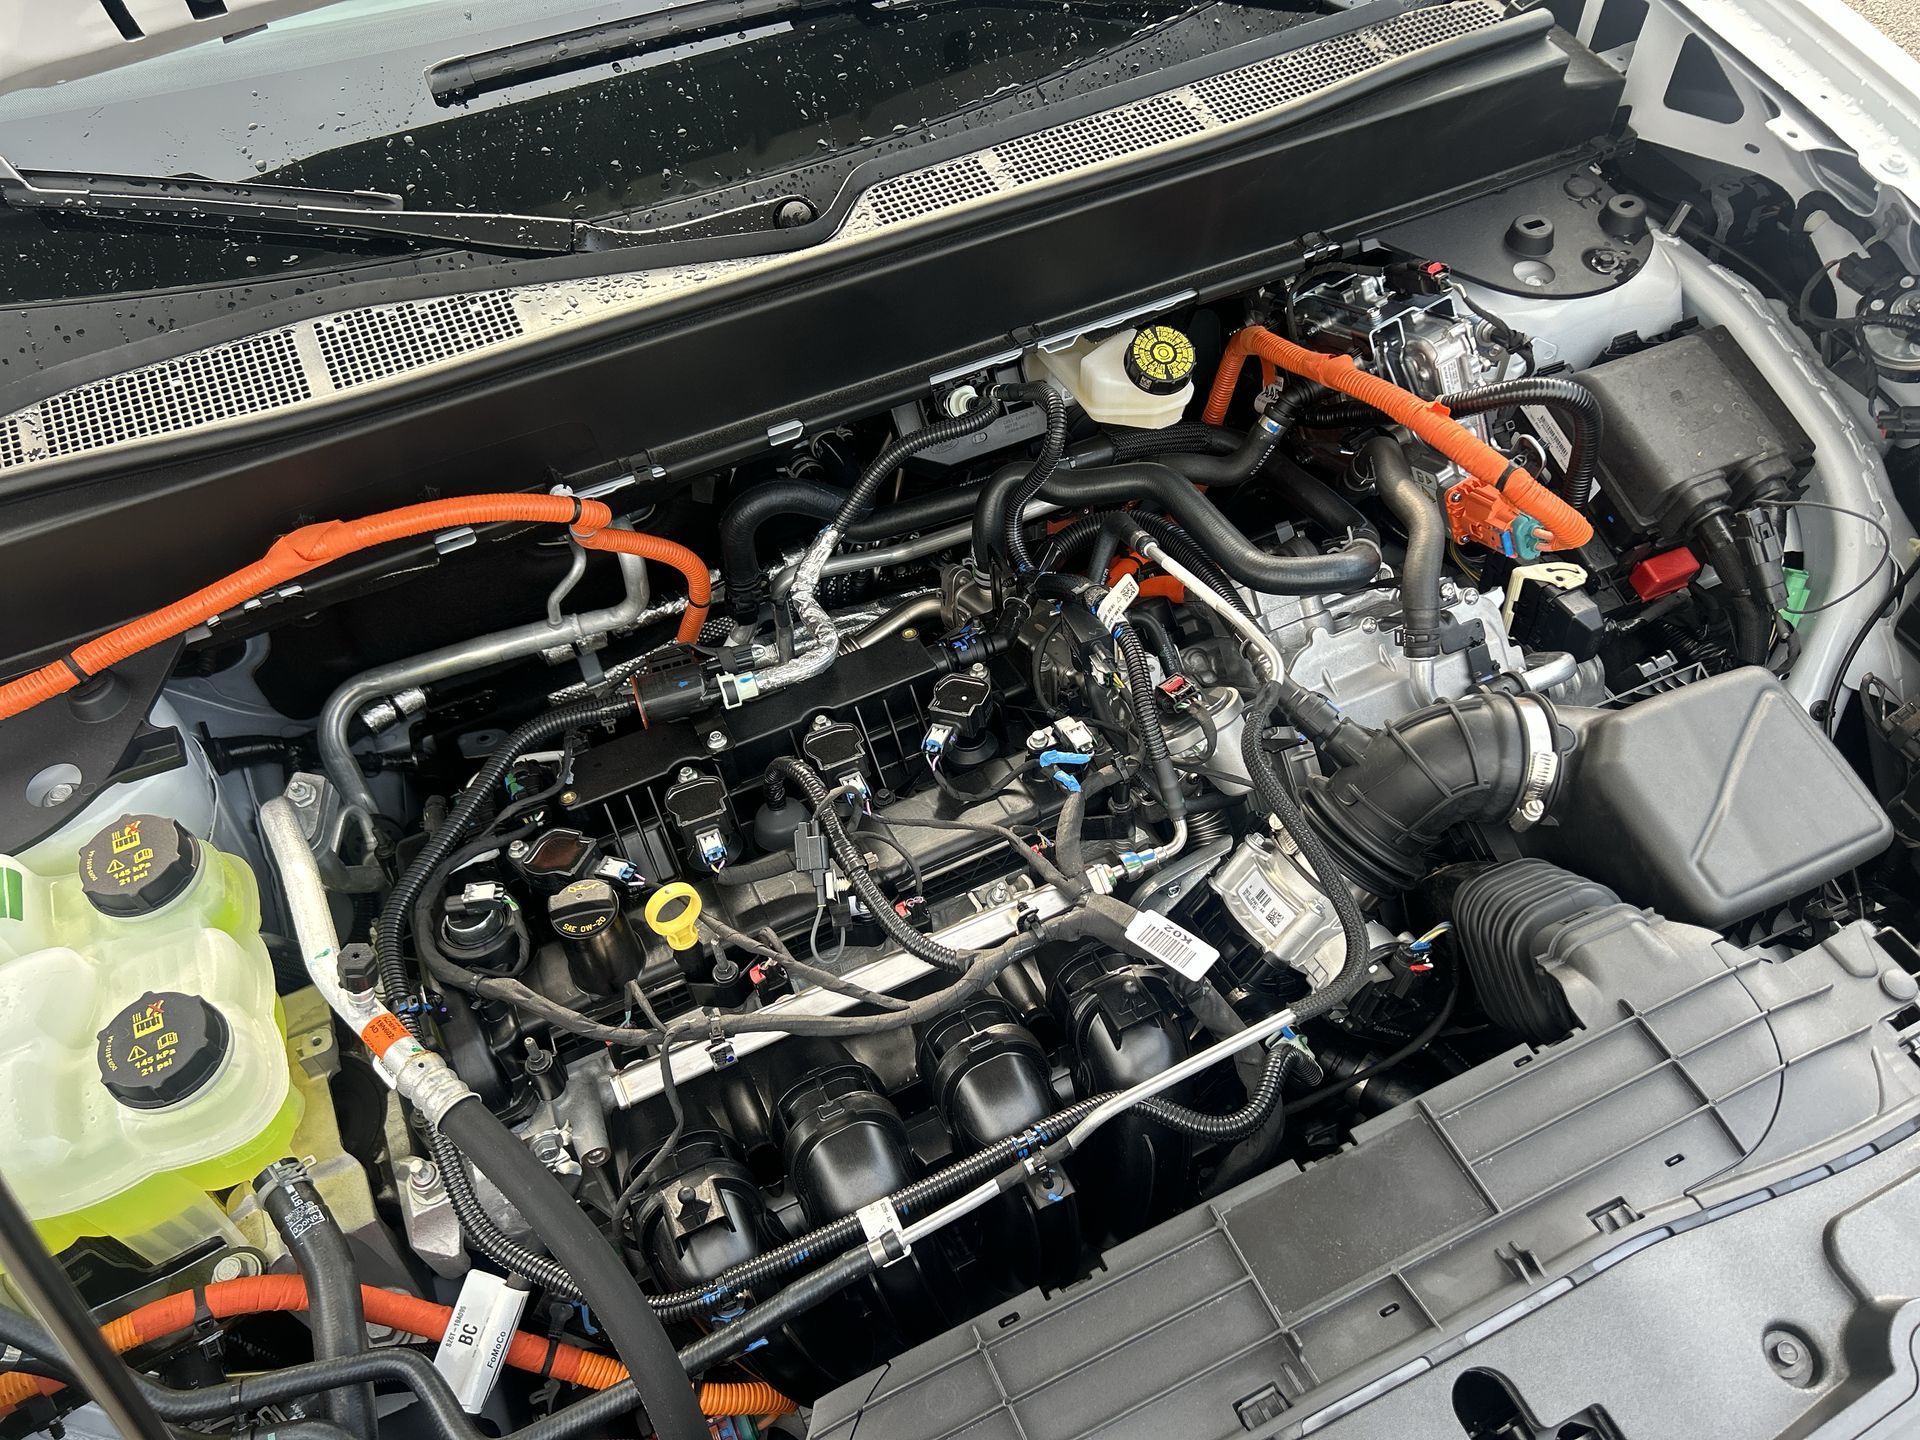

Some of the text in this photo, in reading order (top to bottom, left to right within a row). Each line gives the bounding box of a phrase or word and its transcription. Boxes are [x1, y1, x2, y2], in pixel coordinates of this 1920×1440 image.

[112, 862, 152, 880] 145 kPa
[118, 870, 148, 887] 21 psi
[562, 915, 607, 933] SAE 0W-20
[134, 1048, 176, 1069] 145 kPa
[141, 1057, 173, 1077] 21 psi
[293, 1211, 324, 1234] FoMoCo
[457, 1323, 478, 1347] BC
[486, 1331, 507, 1369] FoMoCo
